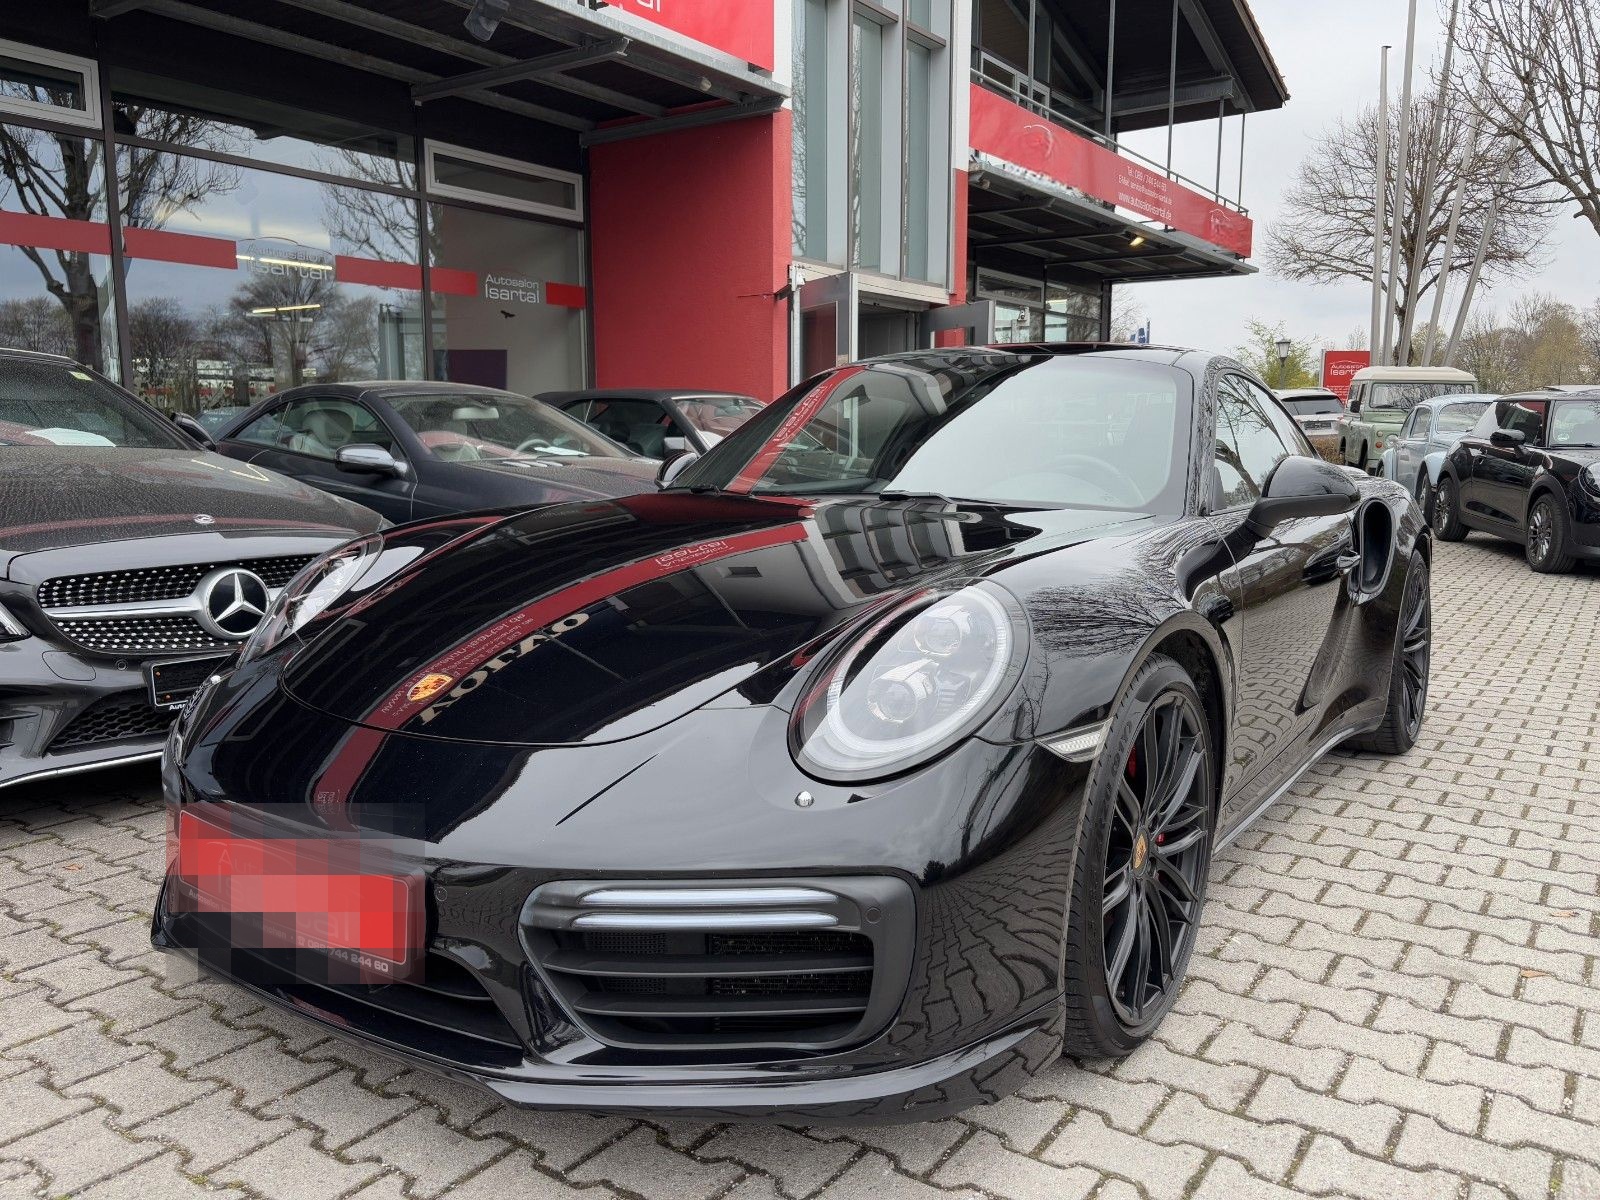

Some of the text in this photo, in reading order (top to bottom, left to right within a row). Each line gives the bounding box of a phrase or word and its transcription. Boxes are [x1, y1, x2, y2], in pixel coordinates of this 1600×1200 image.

[485, 274, 539, 289] Autosalon
[485, 283, 540, 303] Isartal
[350, 953, 372, 969] 244
[373, 960, 389, 973] 60
